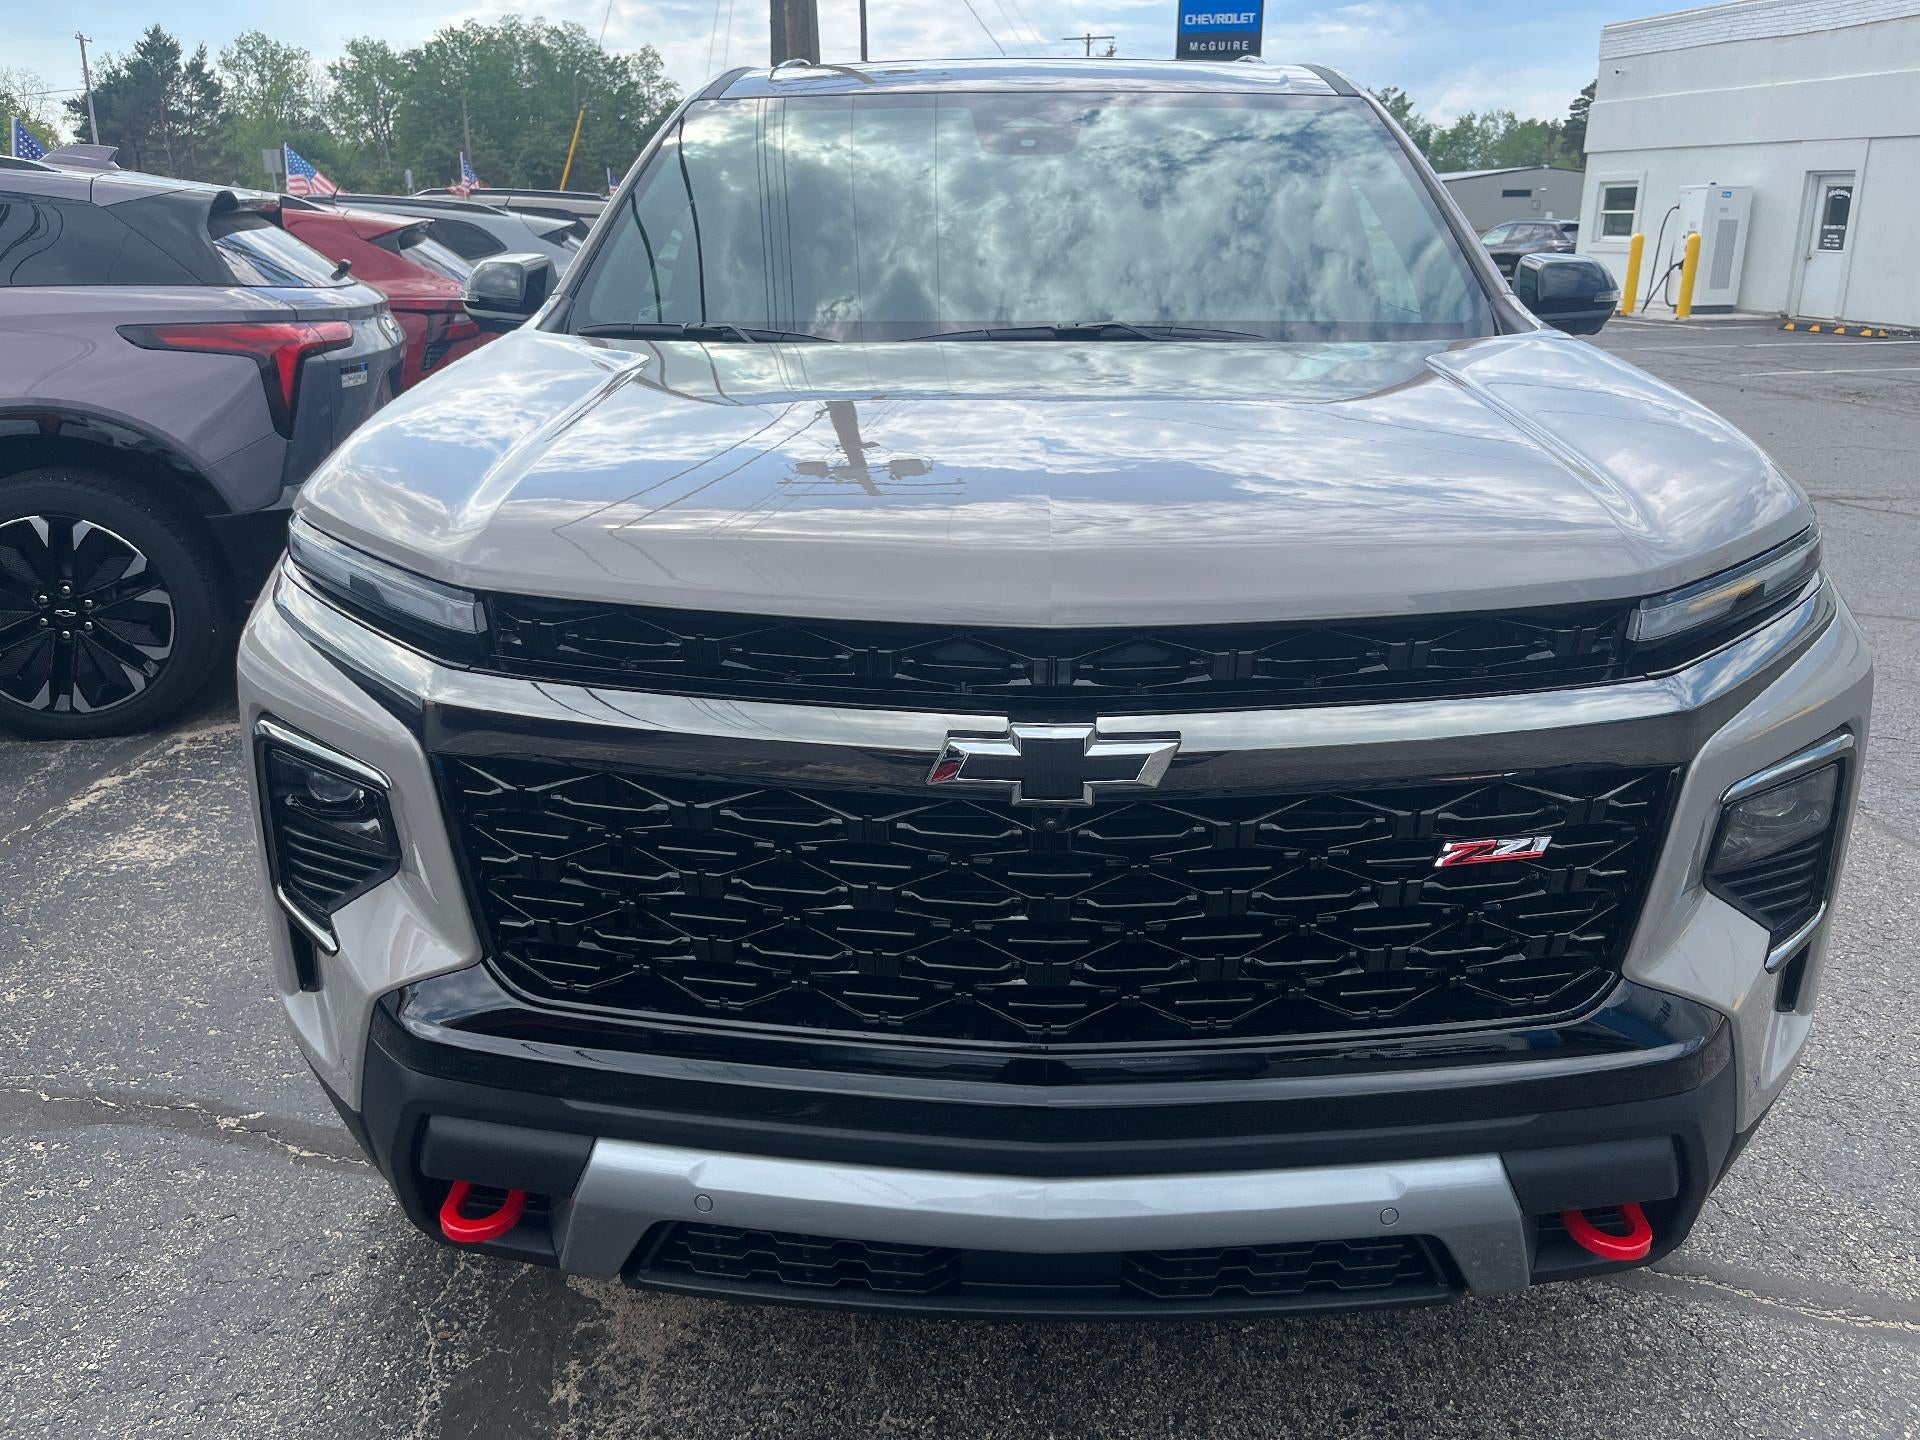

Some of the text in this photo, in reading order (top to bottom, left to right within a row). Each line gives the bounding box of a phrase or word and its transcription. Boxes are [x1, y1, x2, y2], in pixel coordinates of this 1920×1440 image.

[1184, 12, 1256, 25] CHEVROLET
[1189, 40, 1249, 51] McGUIRE
[1434, 835, 1552, 867] Z71
